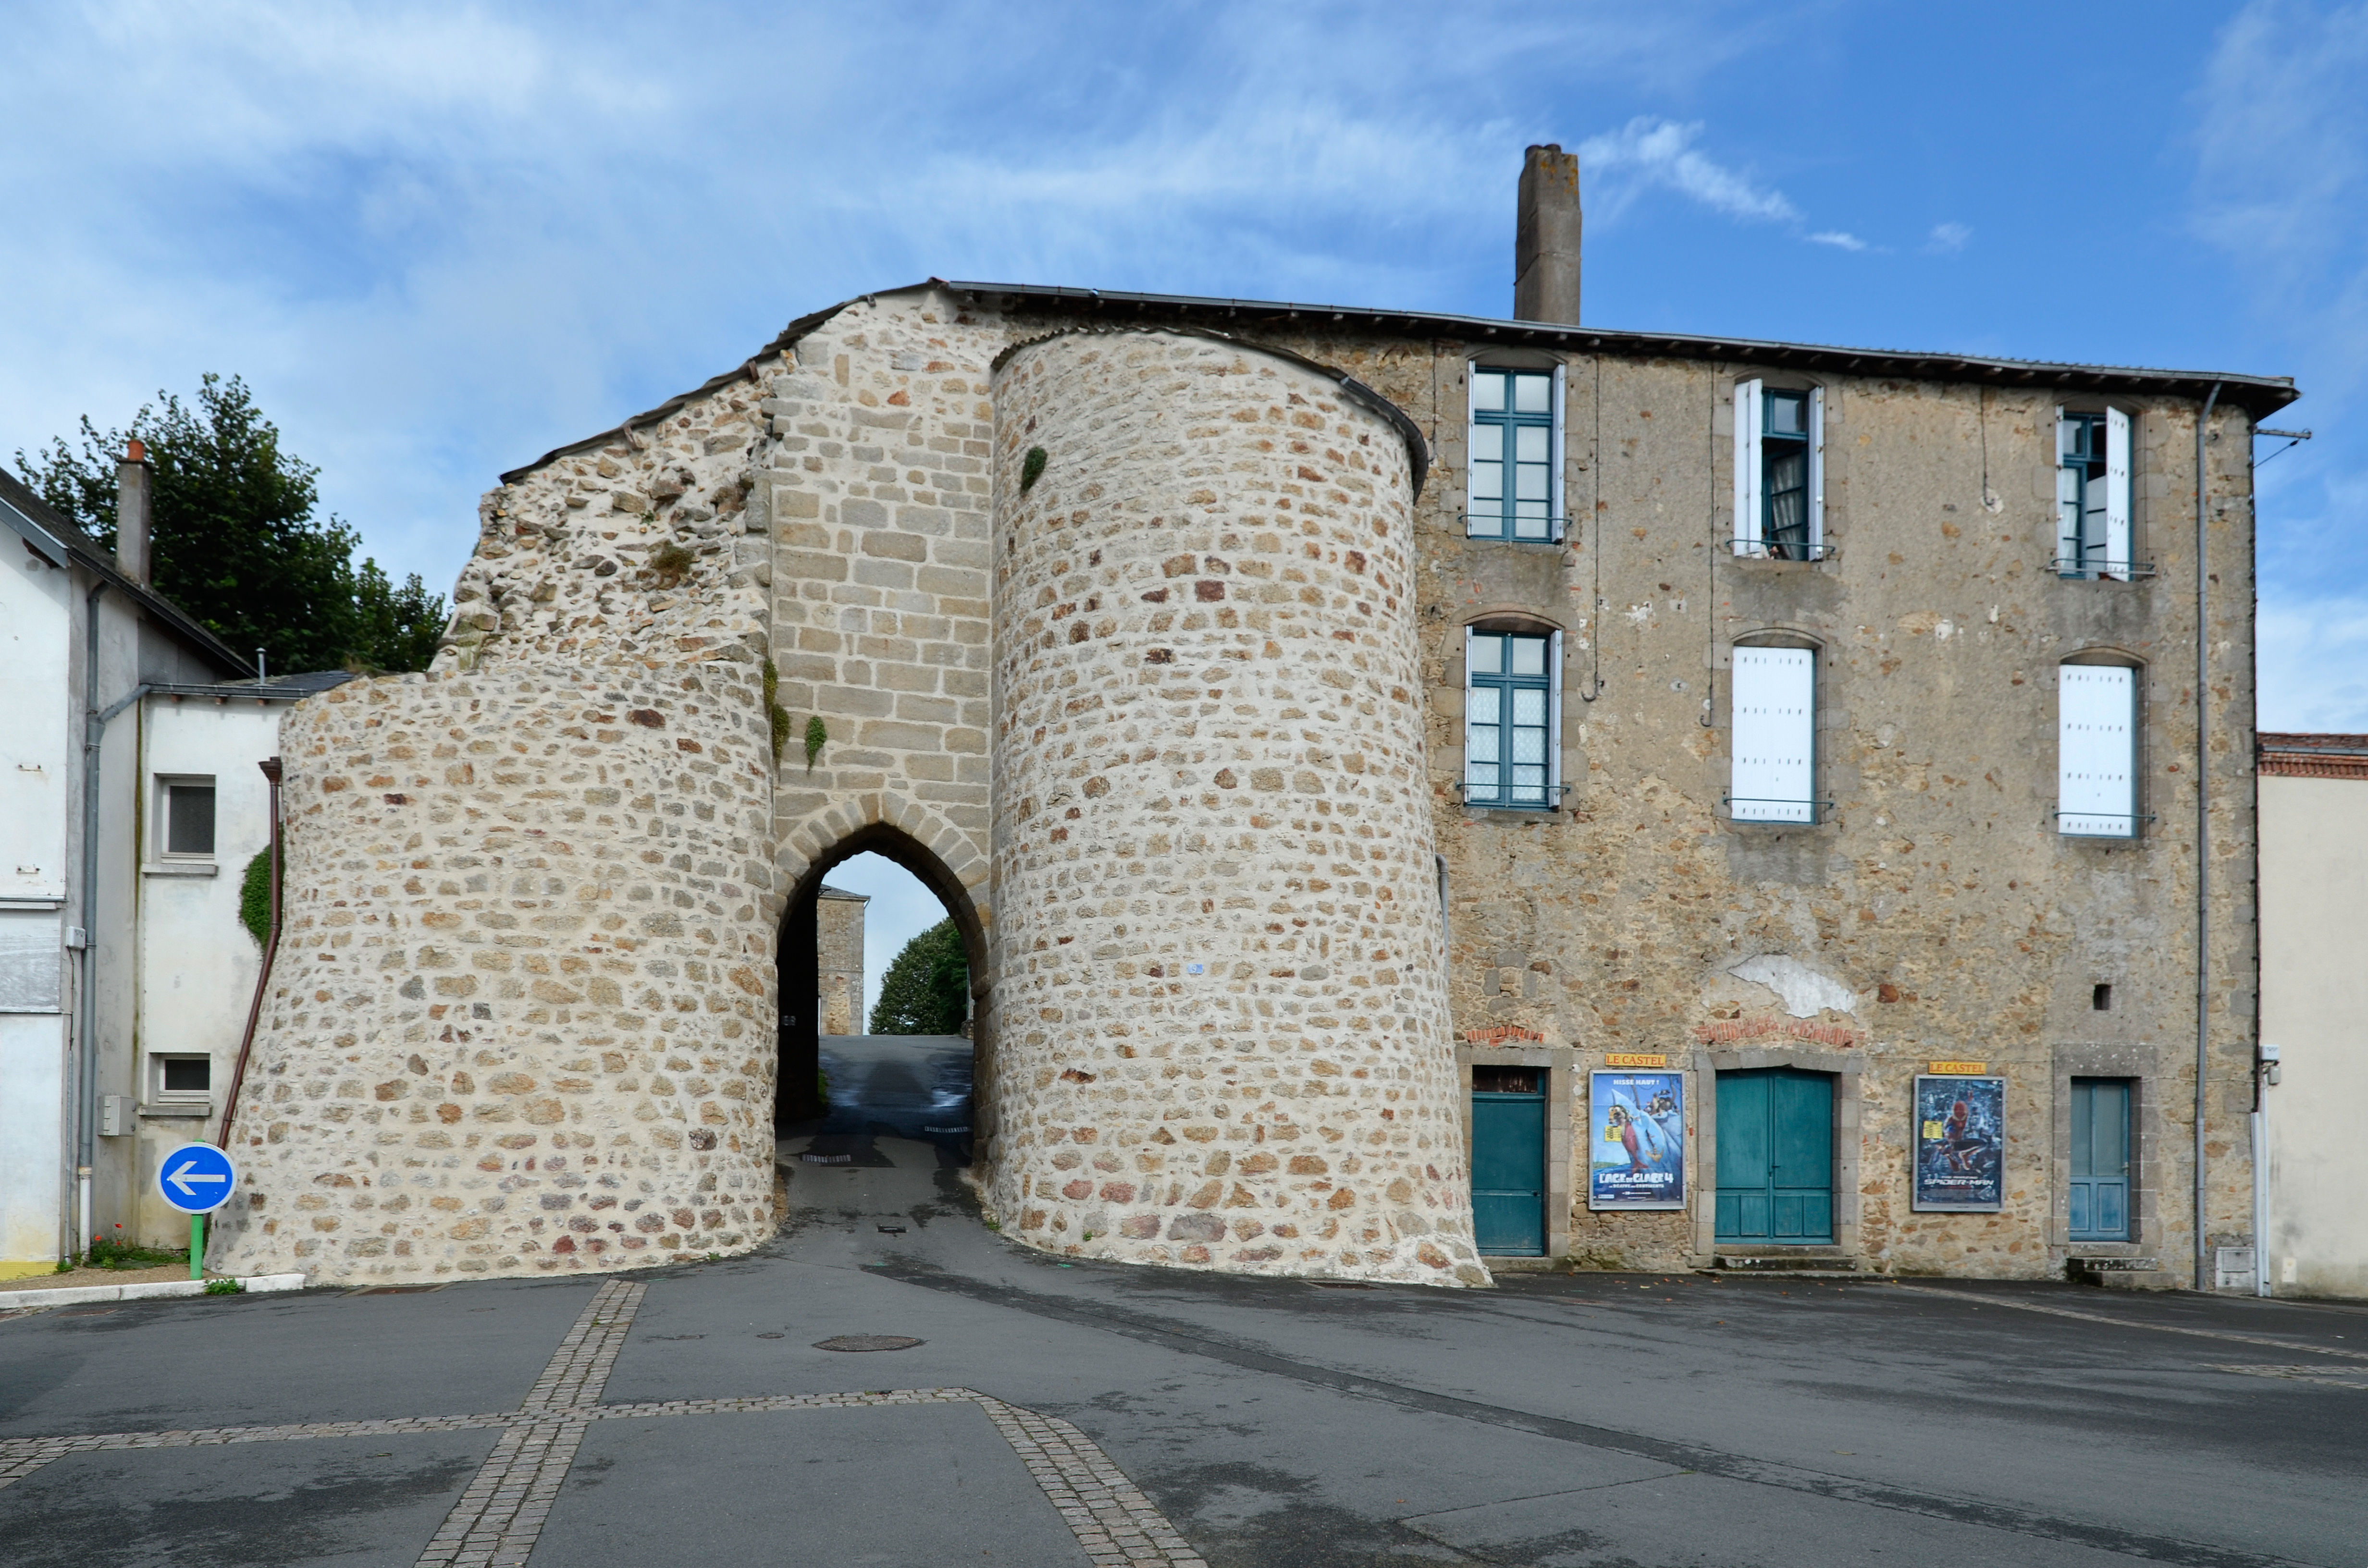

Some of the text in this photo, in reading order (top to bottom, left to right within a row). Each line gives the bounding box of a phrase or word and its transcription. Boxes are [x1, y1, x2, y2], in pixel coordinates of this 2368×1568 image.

[1607, 1055, 1664, 1065] LE CASTEL
[1930, 1064, 1985, 1073] LE CASTEL
[1633, 1173, 1664, 1183] GLACE
[1665, 1173, 1674, 1183] 4
